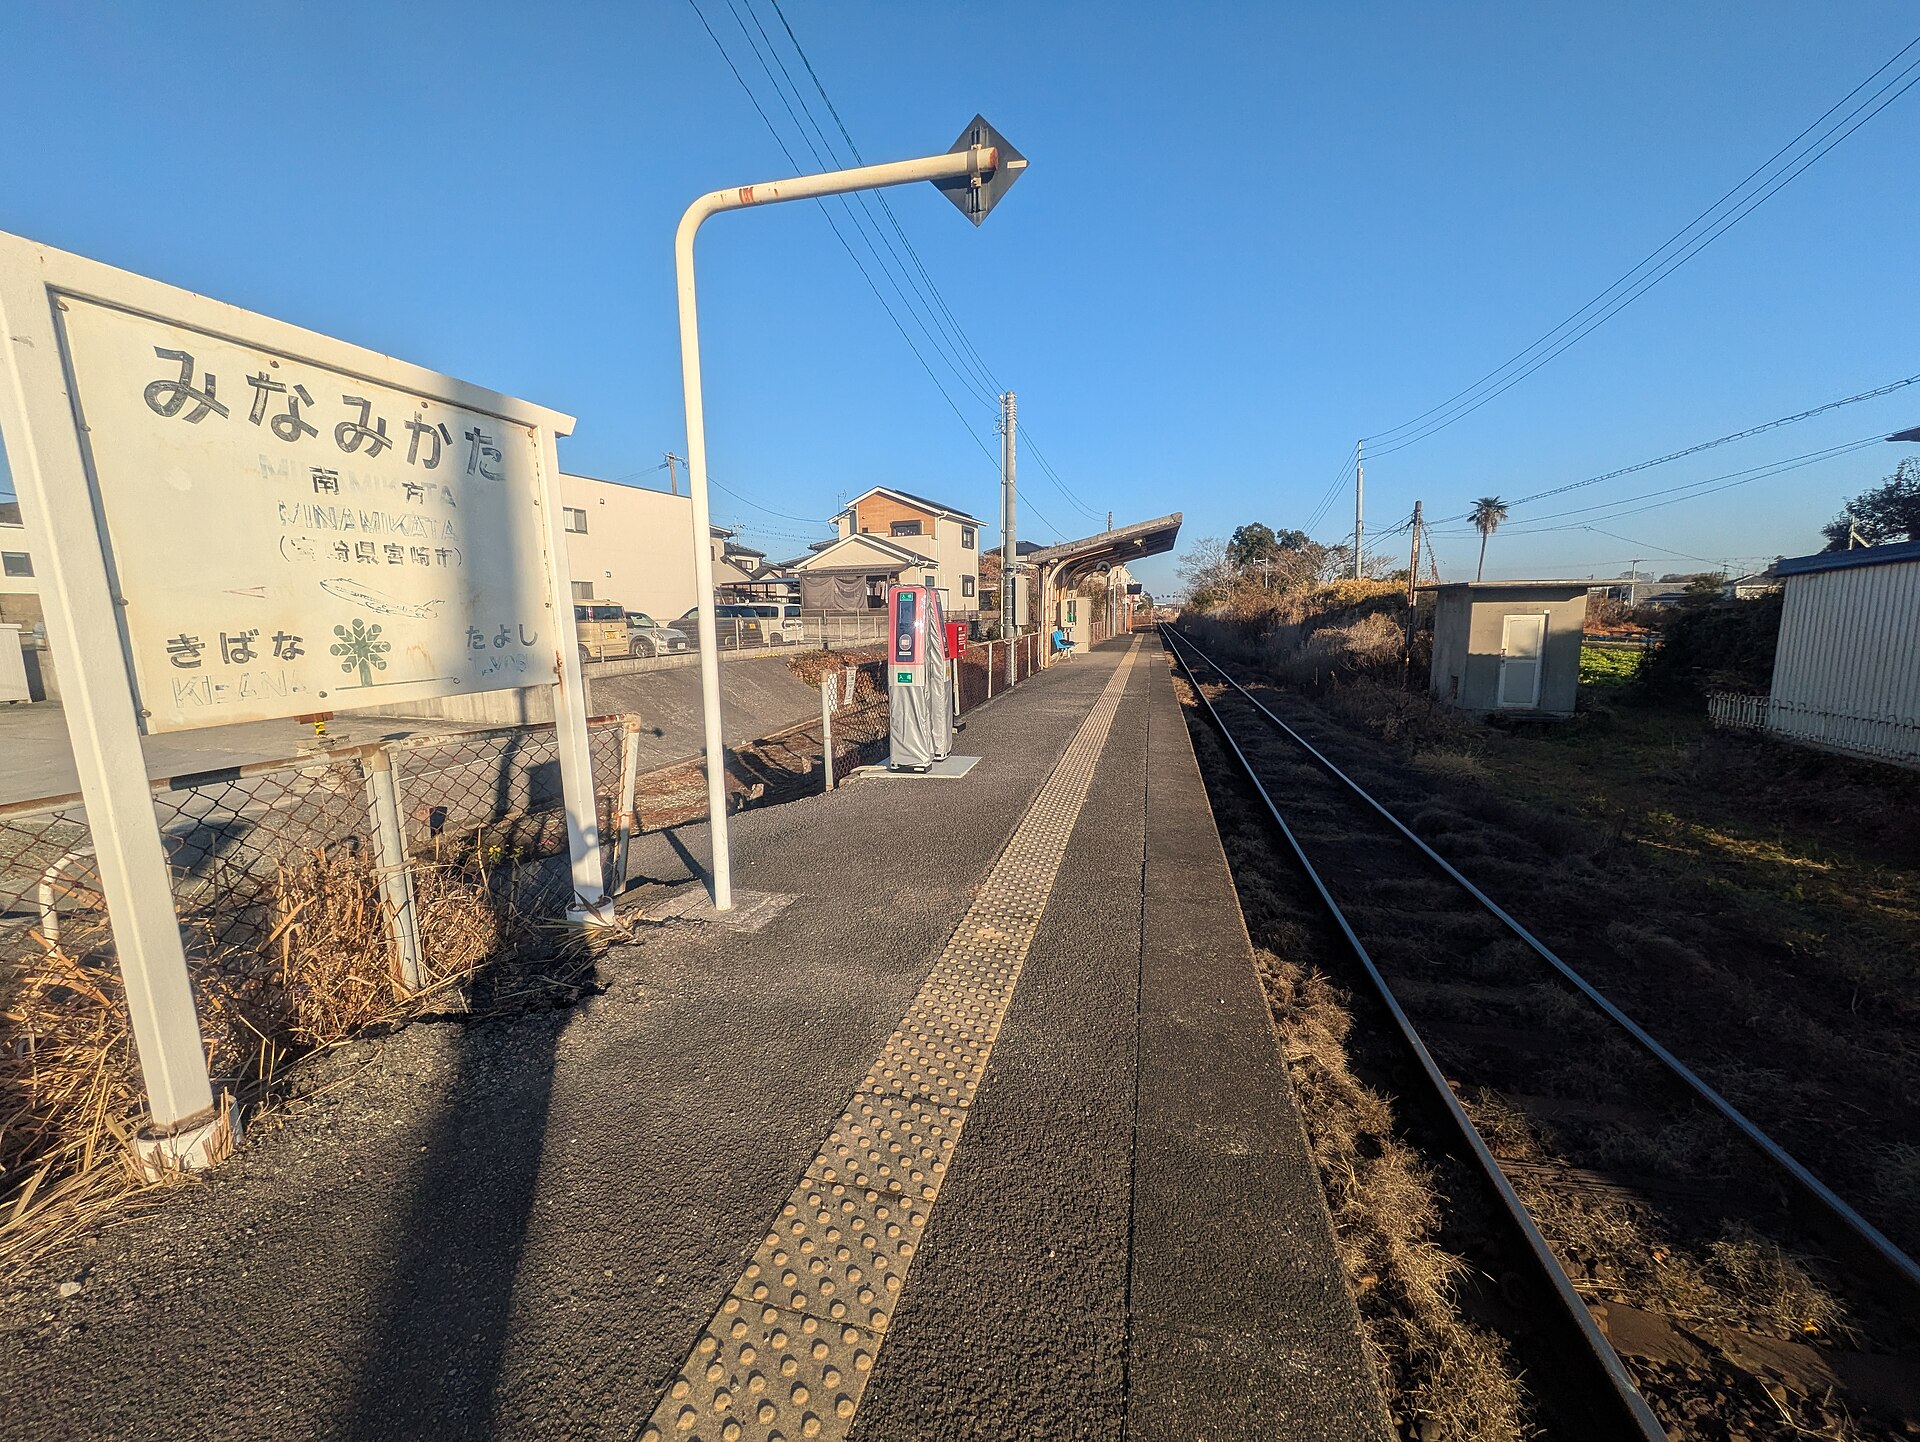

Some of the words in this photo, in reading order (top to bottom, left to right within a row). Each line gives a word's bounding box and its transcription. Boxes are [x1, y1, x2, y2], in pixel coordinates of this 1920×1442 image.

[143, 345, 505, 481] みなみかた
[166, 628, 305, 669] きばな
[465, 623, 539, 650] たよし
